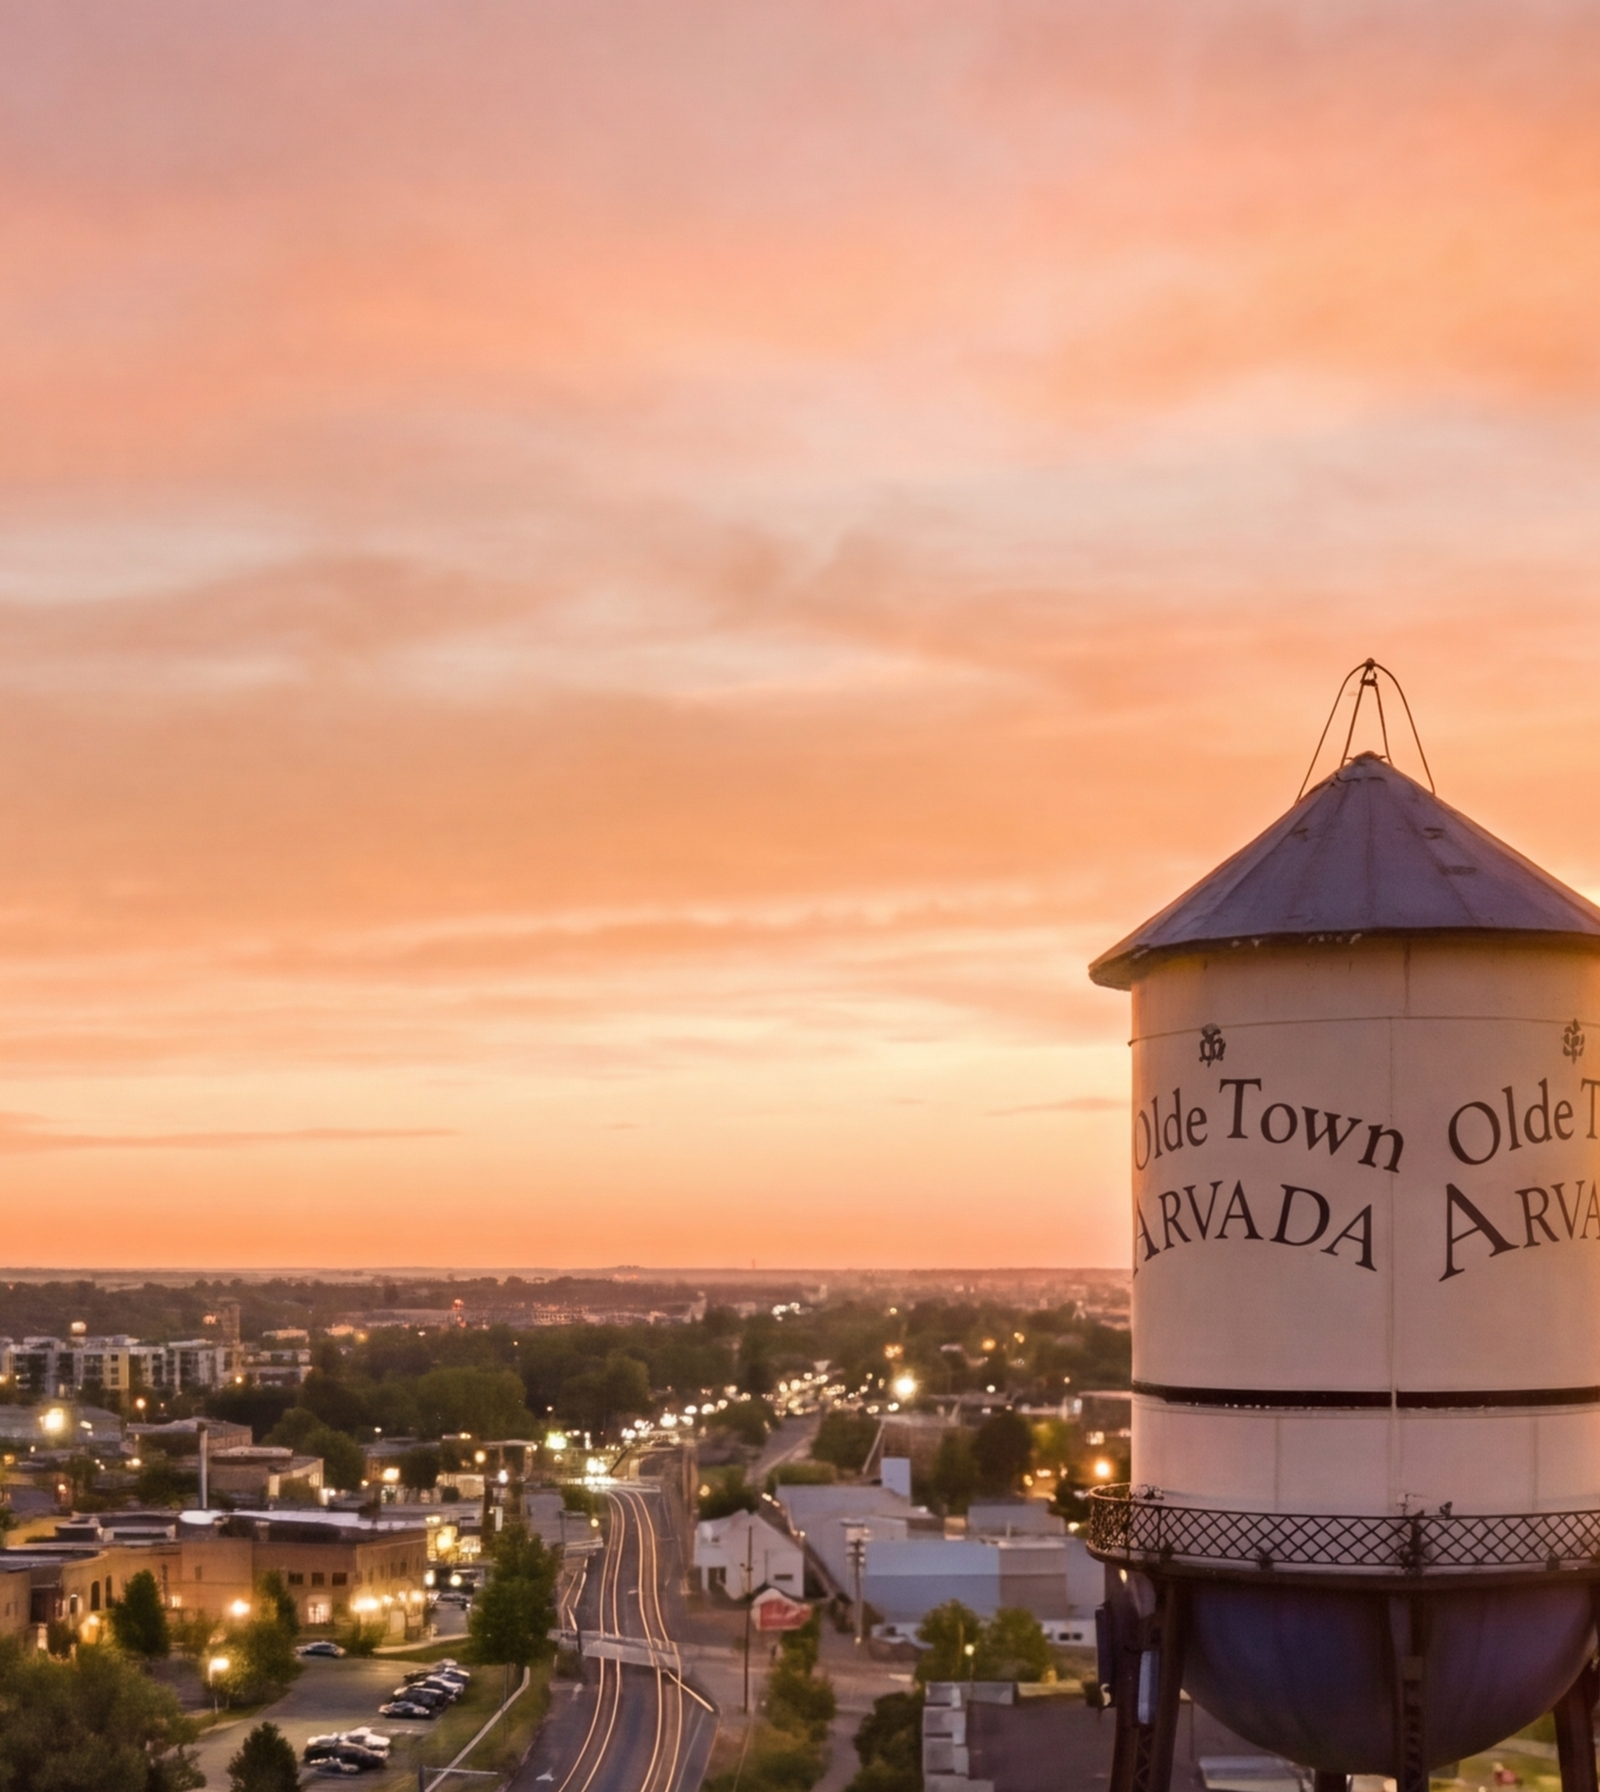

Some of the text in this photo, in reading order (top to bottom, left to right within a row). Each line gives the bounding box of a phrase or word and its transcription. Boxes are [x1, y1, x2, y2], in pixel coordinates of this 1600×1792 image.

[1135, 1078, 1404, 1173] Olde Town
[1447, 1077, 1574, 1165] Olde
[1133, 1179, 1377, 1279] ARVADA
